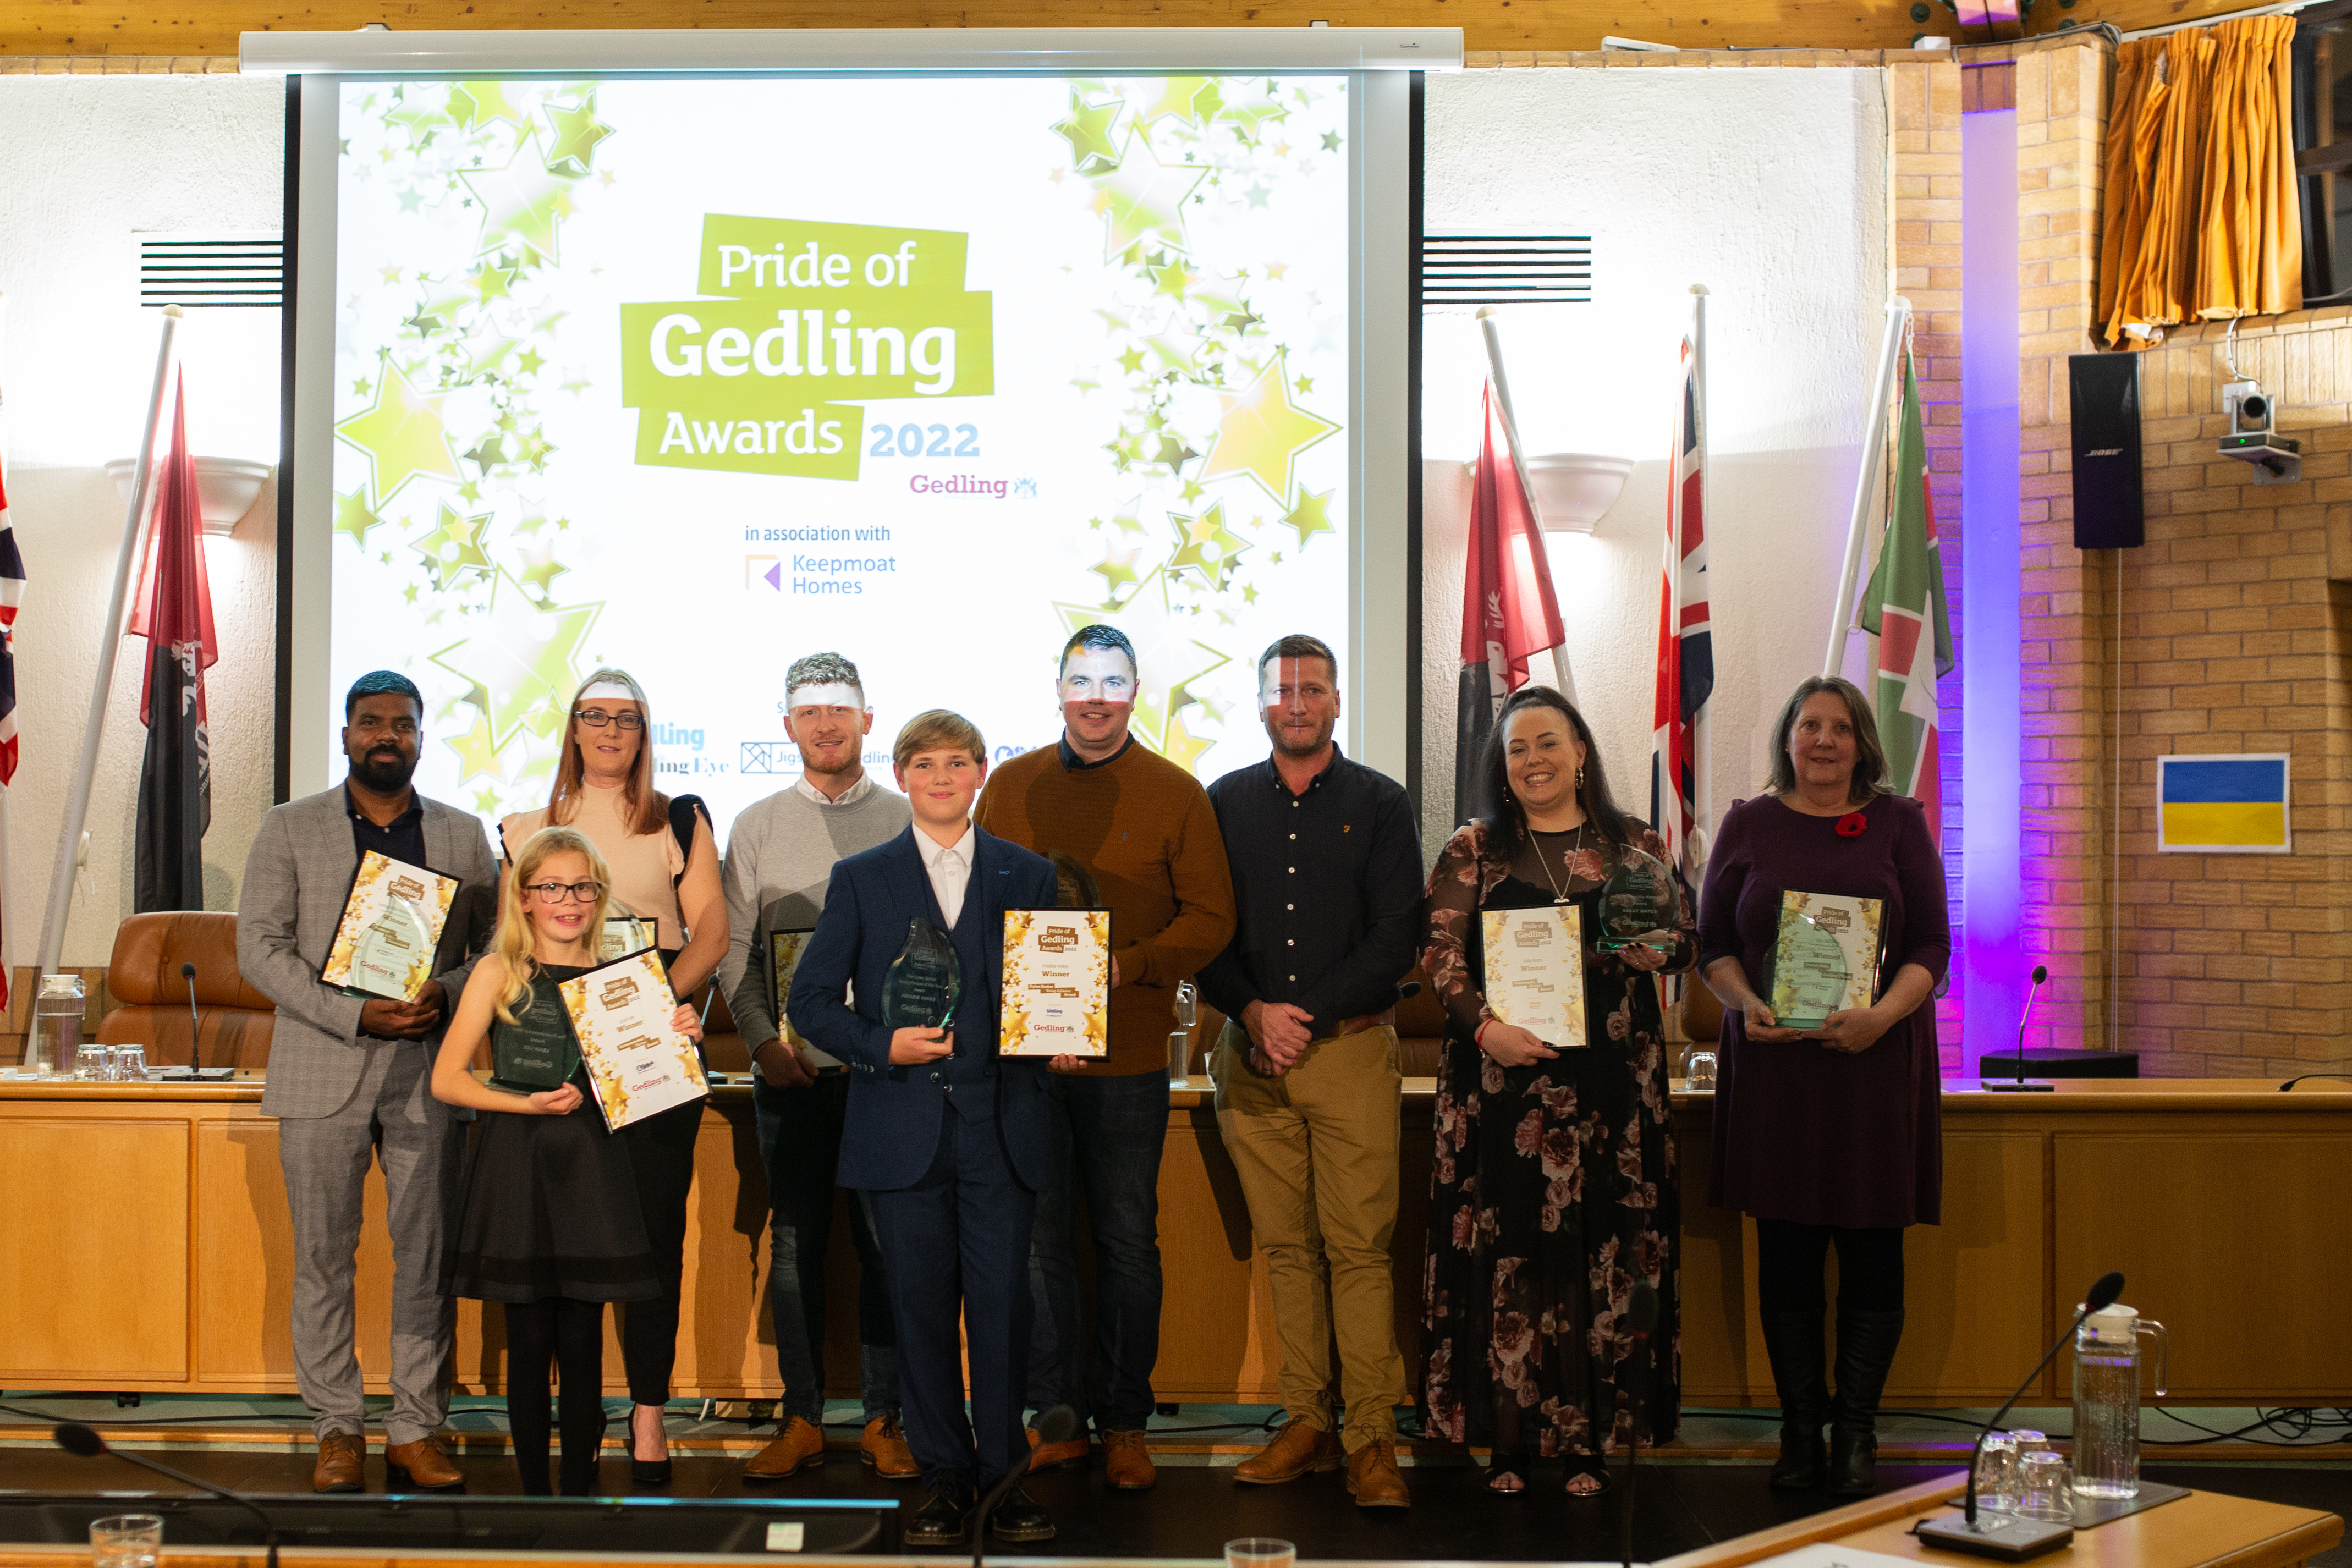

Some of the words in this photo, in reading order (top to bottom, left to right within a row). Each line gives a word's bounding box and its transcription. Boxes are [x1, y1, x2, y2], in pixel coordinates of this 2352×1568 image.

[718, 243, 851, 288] Pride
[865, 240, 917, 288] of
[650, 308, 957, 395] Gedling
[658, 409, 844, 455] Awards
[869, 423, 981, 458] 2022
[2084, 448, 2124, 457] BOSE
[910, 475, 1008, 499] Gedling
[745, 526, 760, 541] in
[764, 526, 850, 541] association
[855, 526, 891, 541] with
[793, 554, 895, 576] Keepmoat
[793, 577, 862, 595] Homes
[651, 722, 705, 751] ling
[653, 755, 690, 774] ling
[777, 751, 802, 765] Jigs
[863, 751, 894, 763] dlin
[390, 883, 422, 899] Gedling
[1816, 916, 1847, 927] Gedling
[1041, 936, 1075, 945] Gedling
[1517, 930, 1548, 939] Gedling
[601, 943, 622, 951] dling
[361, 961, 388, 975] Gedling
[602, 986, 636, 1000] Gedling
[616, 1019, 644, 1033] Winner
[632, 1077, 662, 1092] Gedling
